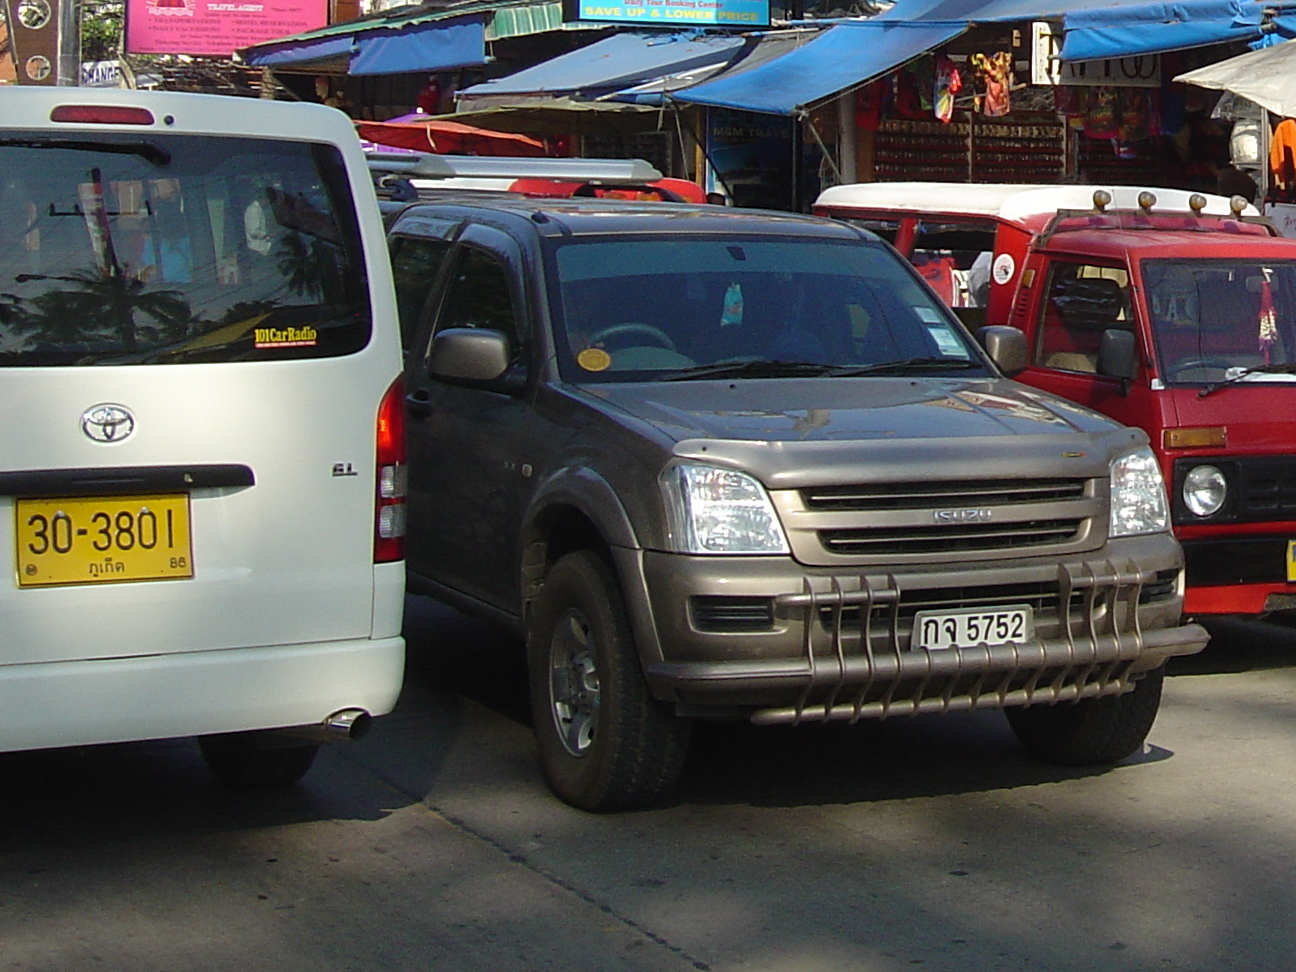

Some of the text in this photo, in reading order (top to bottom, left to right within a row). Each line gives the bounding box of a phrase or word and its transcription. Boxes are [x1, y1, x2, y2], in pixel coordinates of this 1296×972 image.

[665, 0, 696, 9] Booking
[698, 1, 723, 9] Center
[584, 7, 758, 21] SAVE UP & LOWER PRICE
[933, 509, 992, 524] ISUZU
[27, 508, 174, 555] 30-3801
[966, 612, 1024, 642] 5752
